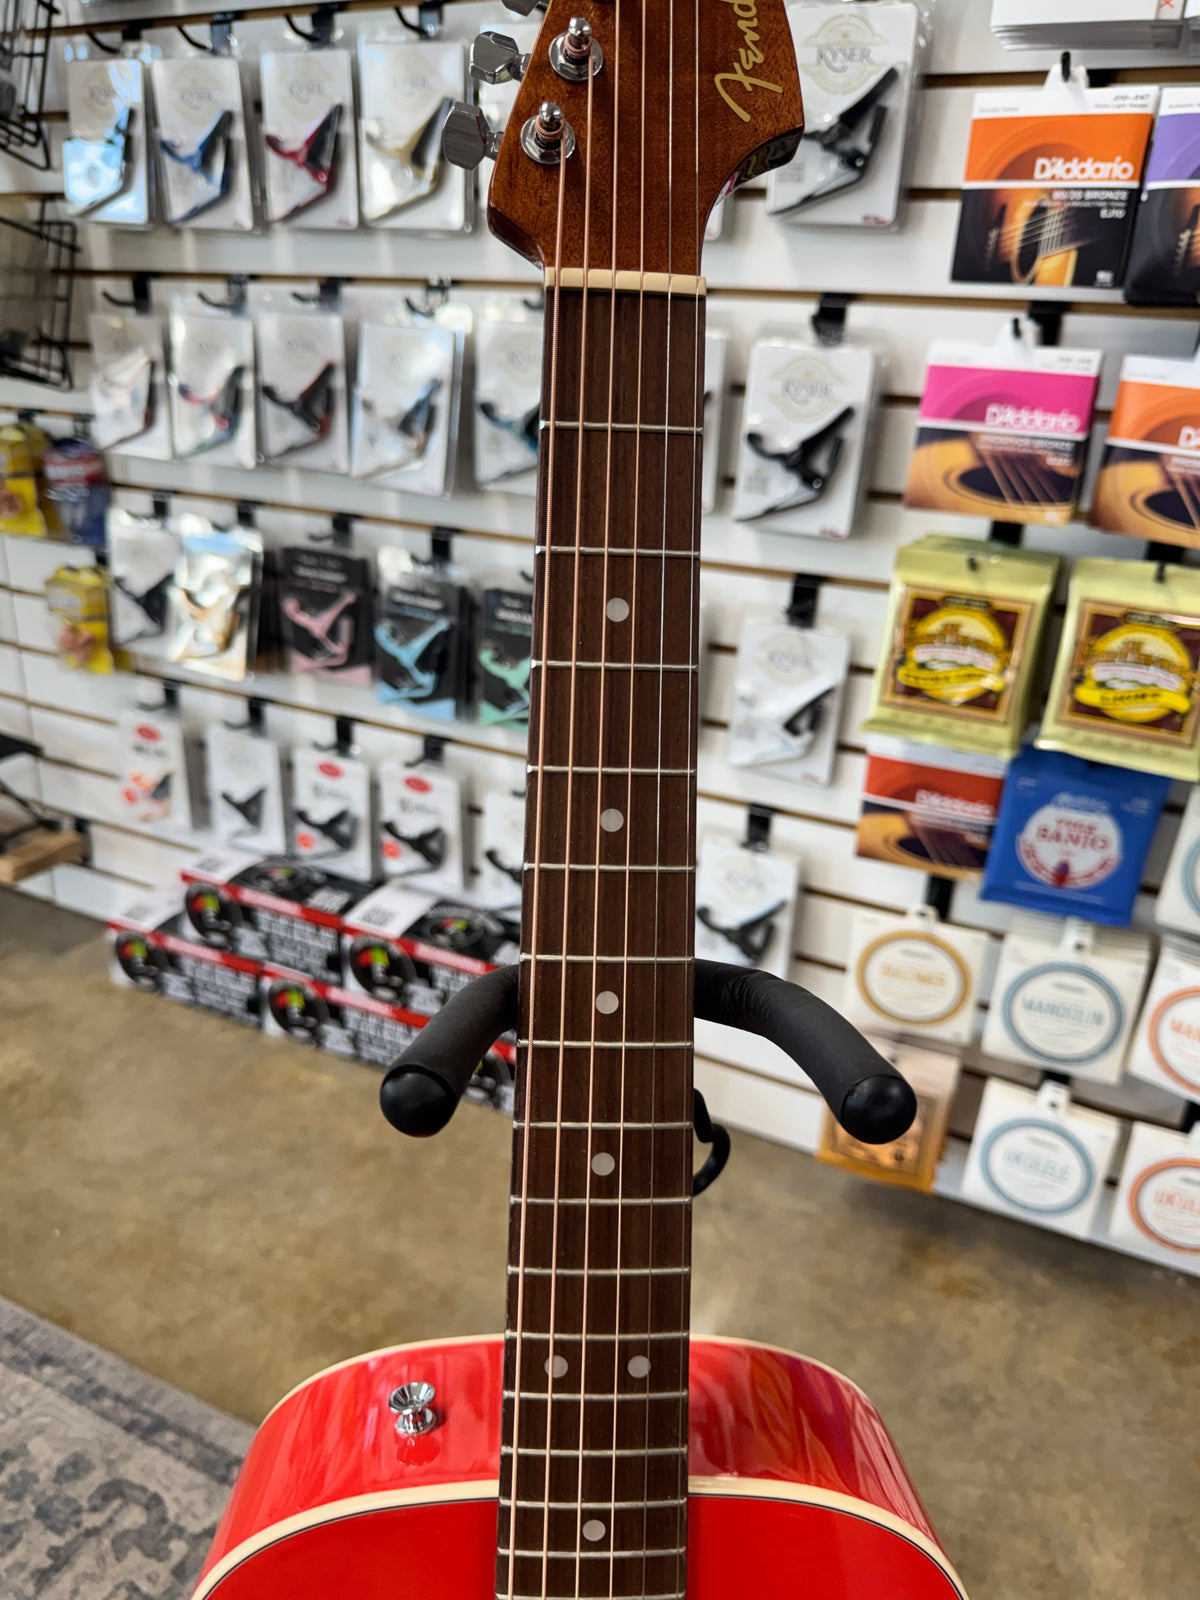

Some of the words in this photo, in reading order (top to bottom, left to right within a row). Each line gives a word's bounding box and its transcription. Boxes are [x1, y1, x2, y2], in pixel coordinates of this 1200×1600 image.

[1033, 156, 1135, 180] D'Addario
[984, 403, 1081, 433] D'Addario
[1036, 824, 1110, 854] BANJO
